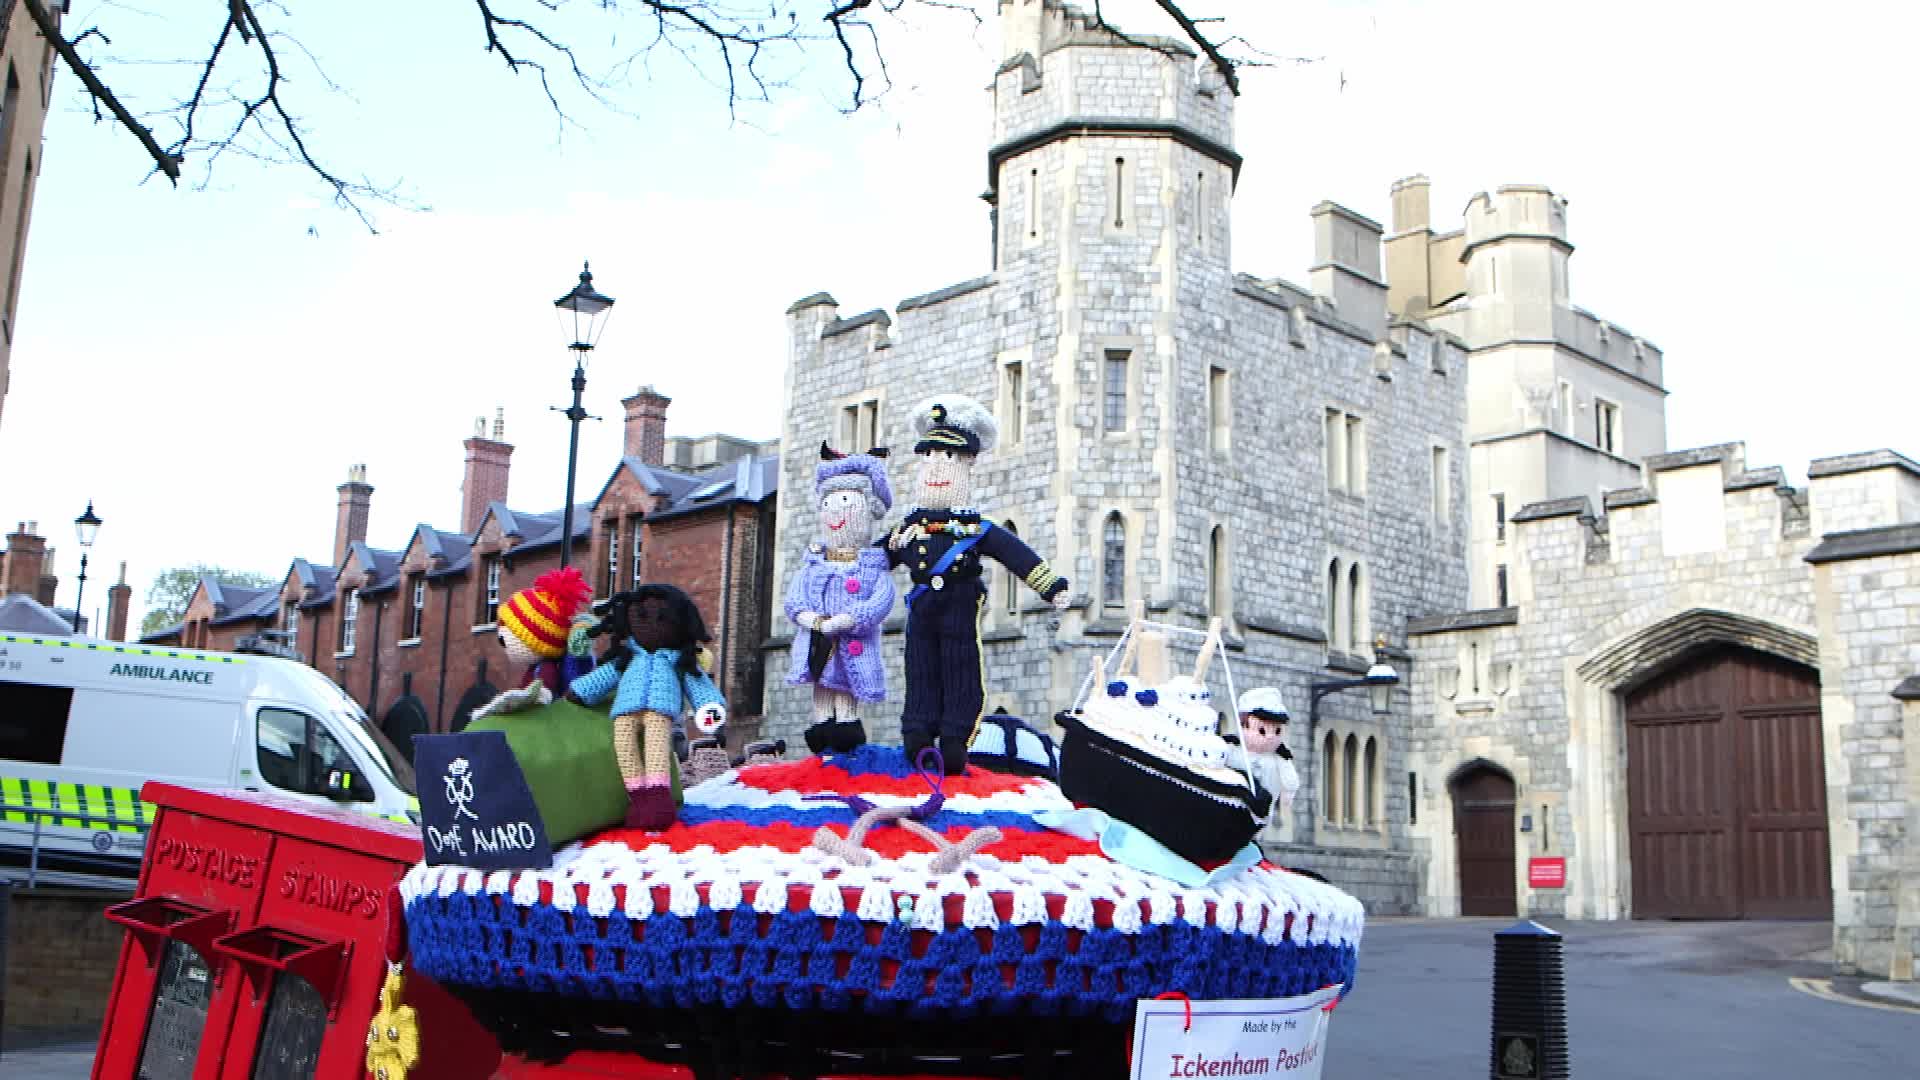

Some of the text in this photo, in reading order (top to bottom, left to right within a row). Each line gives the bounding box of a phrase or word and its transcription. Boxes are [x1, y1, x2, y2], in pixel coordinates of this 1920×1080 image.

[110, 663, 215, 685] AMBULANCE
[472, 821, 536, 855] AWARD
[155, 838, 261, 889] POSTAGE
[280, 867, 383, 919] STAMPS
[1242, 1014, 1297, 1035] Made by the
[1169, 1052, 1269, 1078] Ickenham
